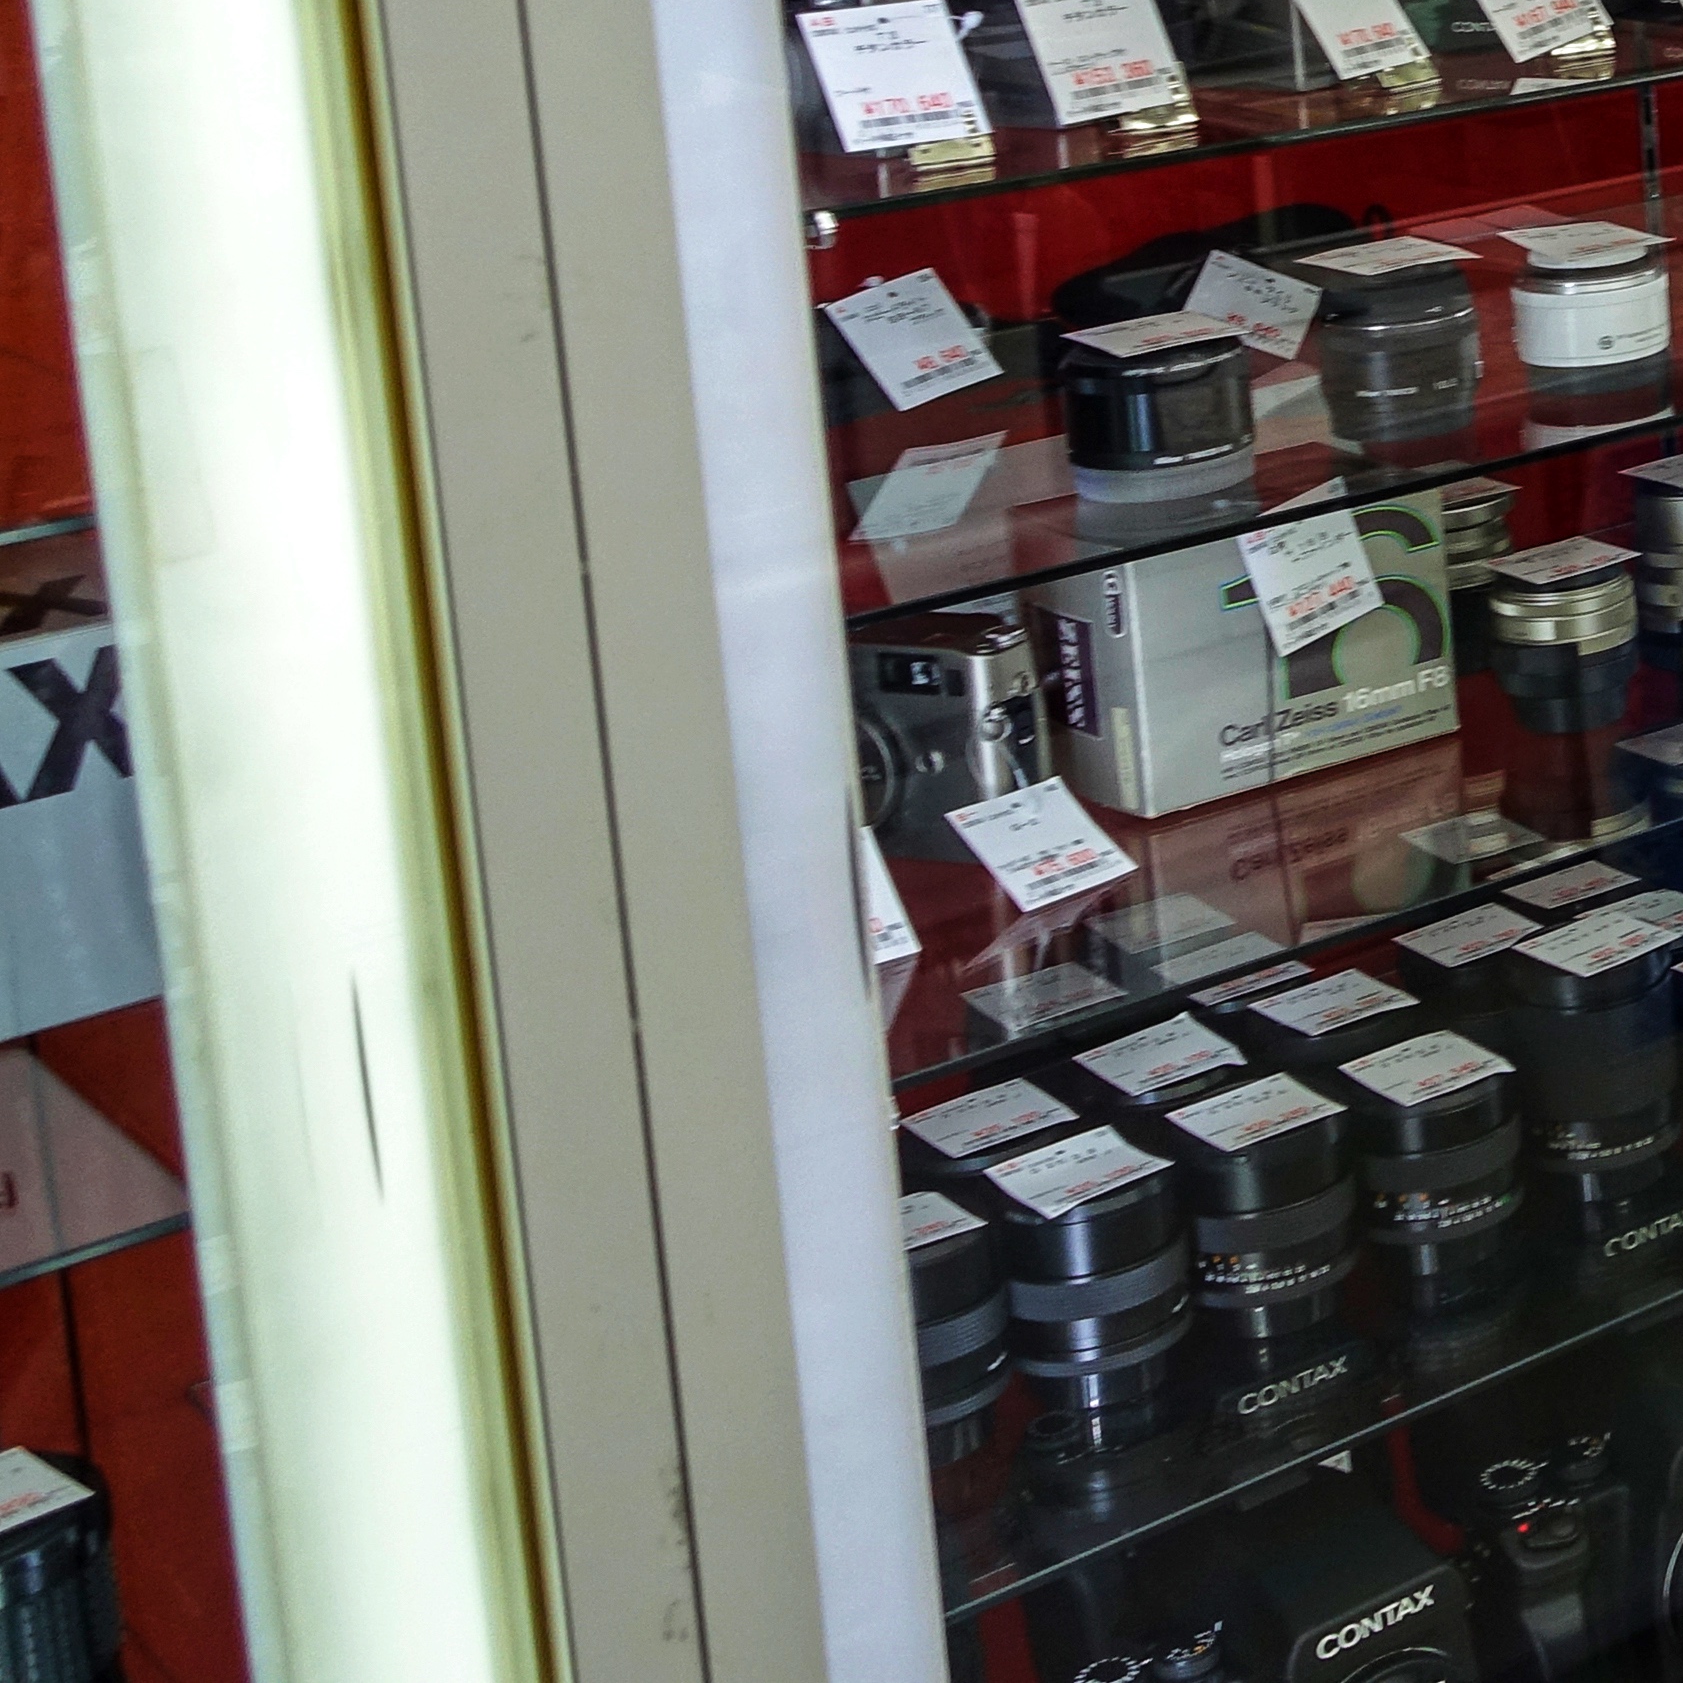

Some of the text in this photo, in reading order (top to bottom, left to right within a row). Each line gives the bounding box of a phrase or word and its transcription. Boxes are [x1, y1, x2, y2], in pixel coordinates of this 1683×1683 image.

[0, 644, 132, 810] X
[1219, 665, 1450, 747] Carl Zeiss 16mm F8
[1237, 1353, 1349, 1416] CONTAX
[1315, 1583, 1435, 1662] CONTAX
